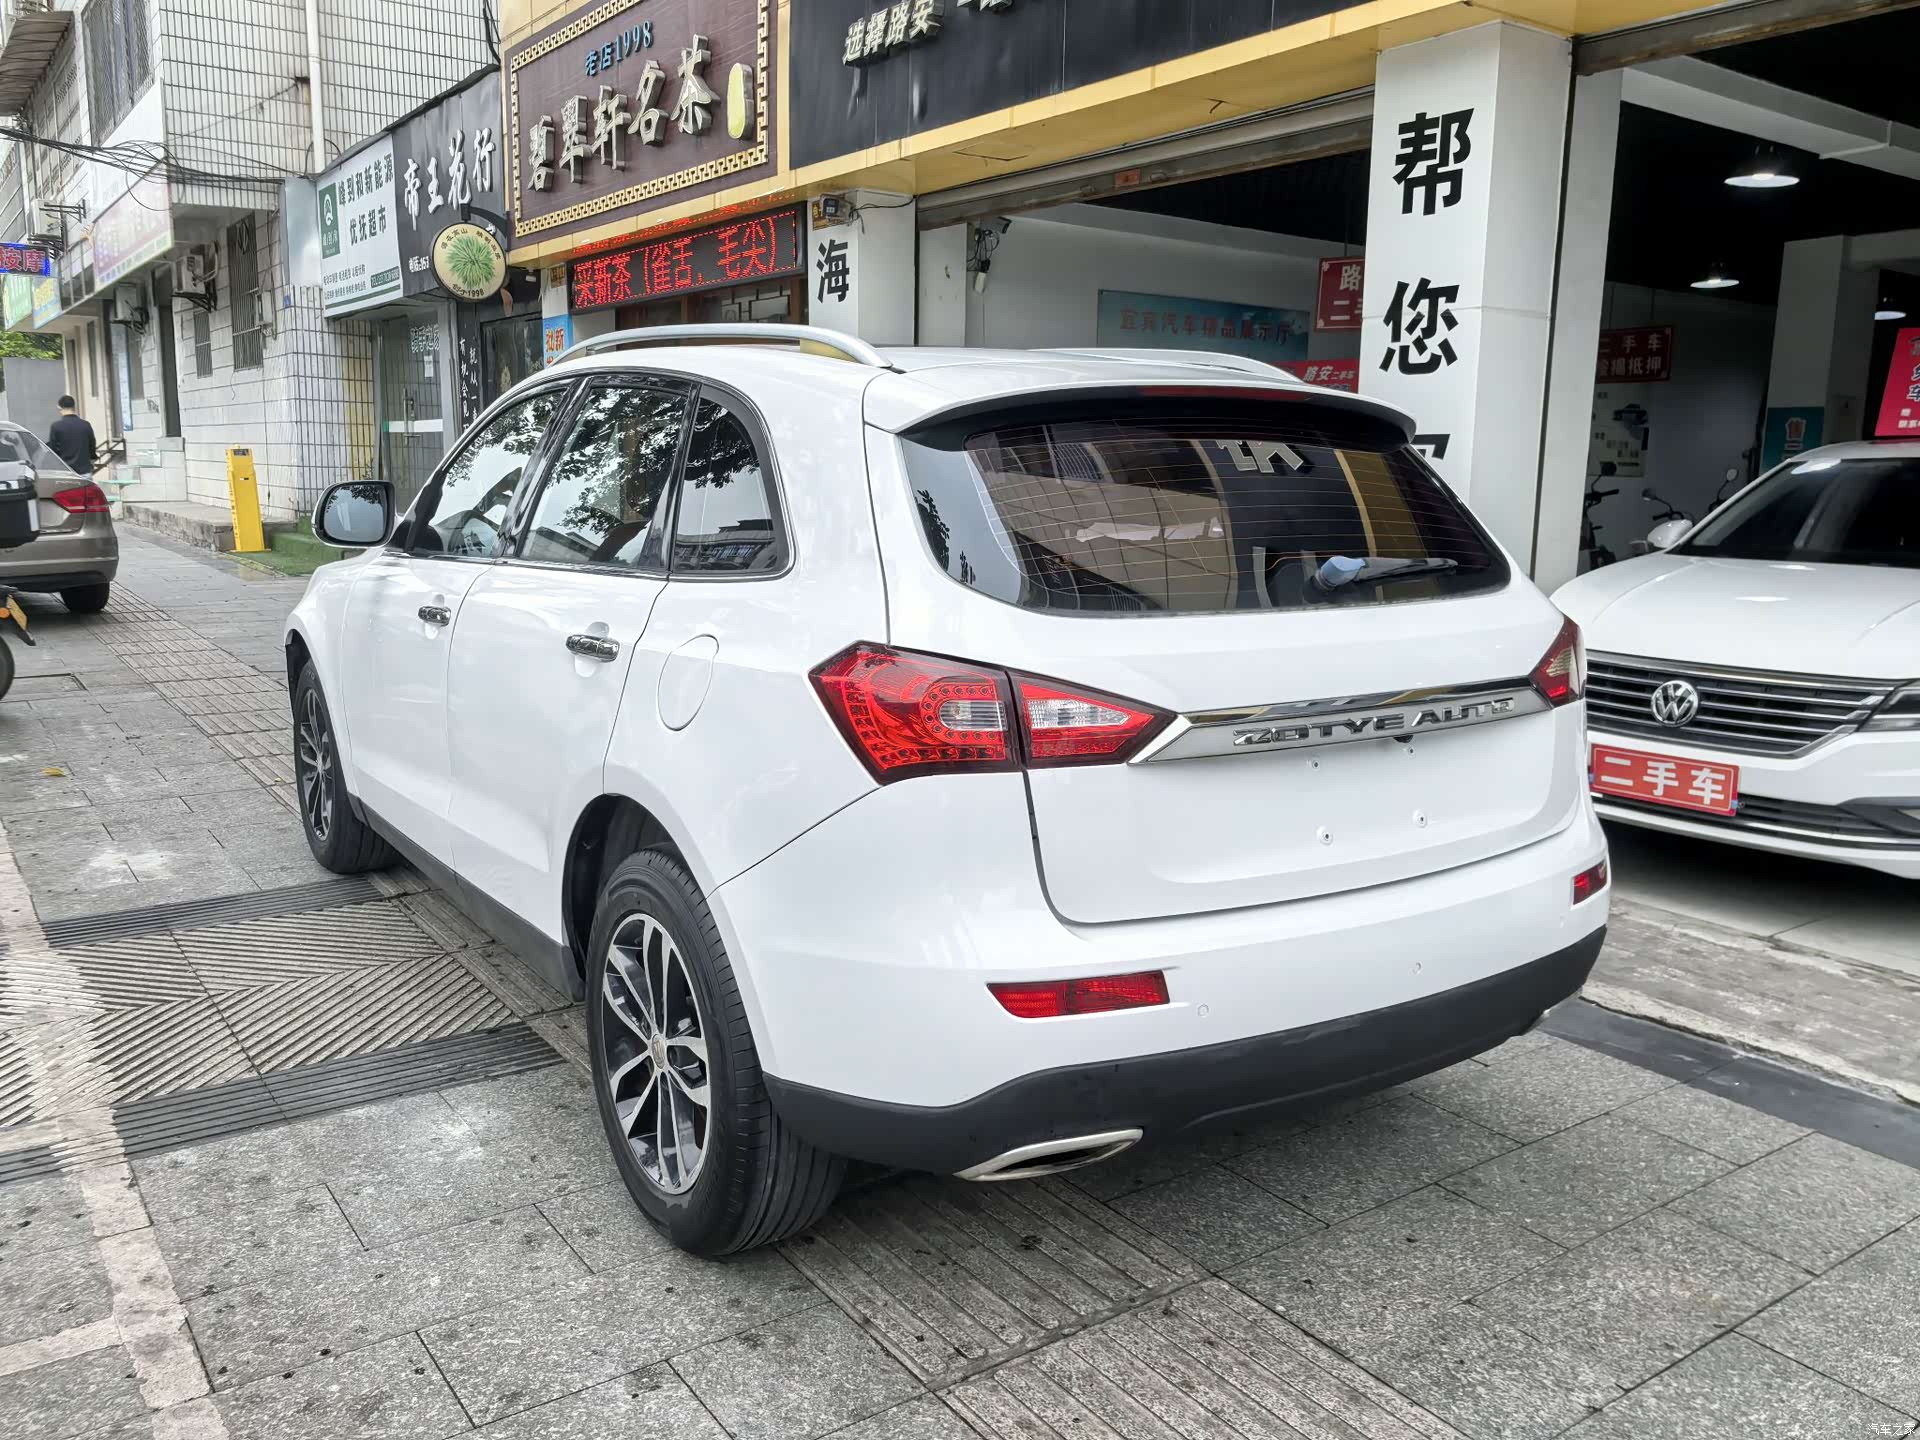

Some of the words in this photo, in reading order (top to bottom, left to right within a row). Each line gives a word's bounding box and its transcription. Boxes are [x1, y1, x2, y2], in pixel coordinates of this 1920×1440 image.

[585, 20, 654, 77] 老店1998
[842, 0, 941, 66] 选择路安
[527, 33, 720, 192] 碧翠轩名茶
[403, 127, 496, 231] 帝王花行
[816, 238, 851, 303] 海
[1233, 712, 1405, 746] ZOTYE
[1411, 697, 1515, 727] AUTO
[1600, 755, 1726, 805] 二手车
